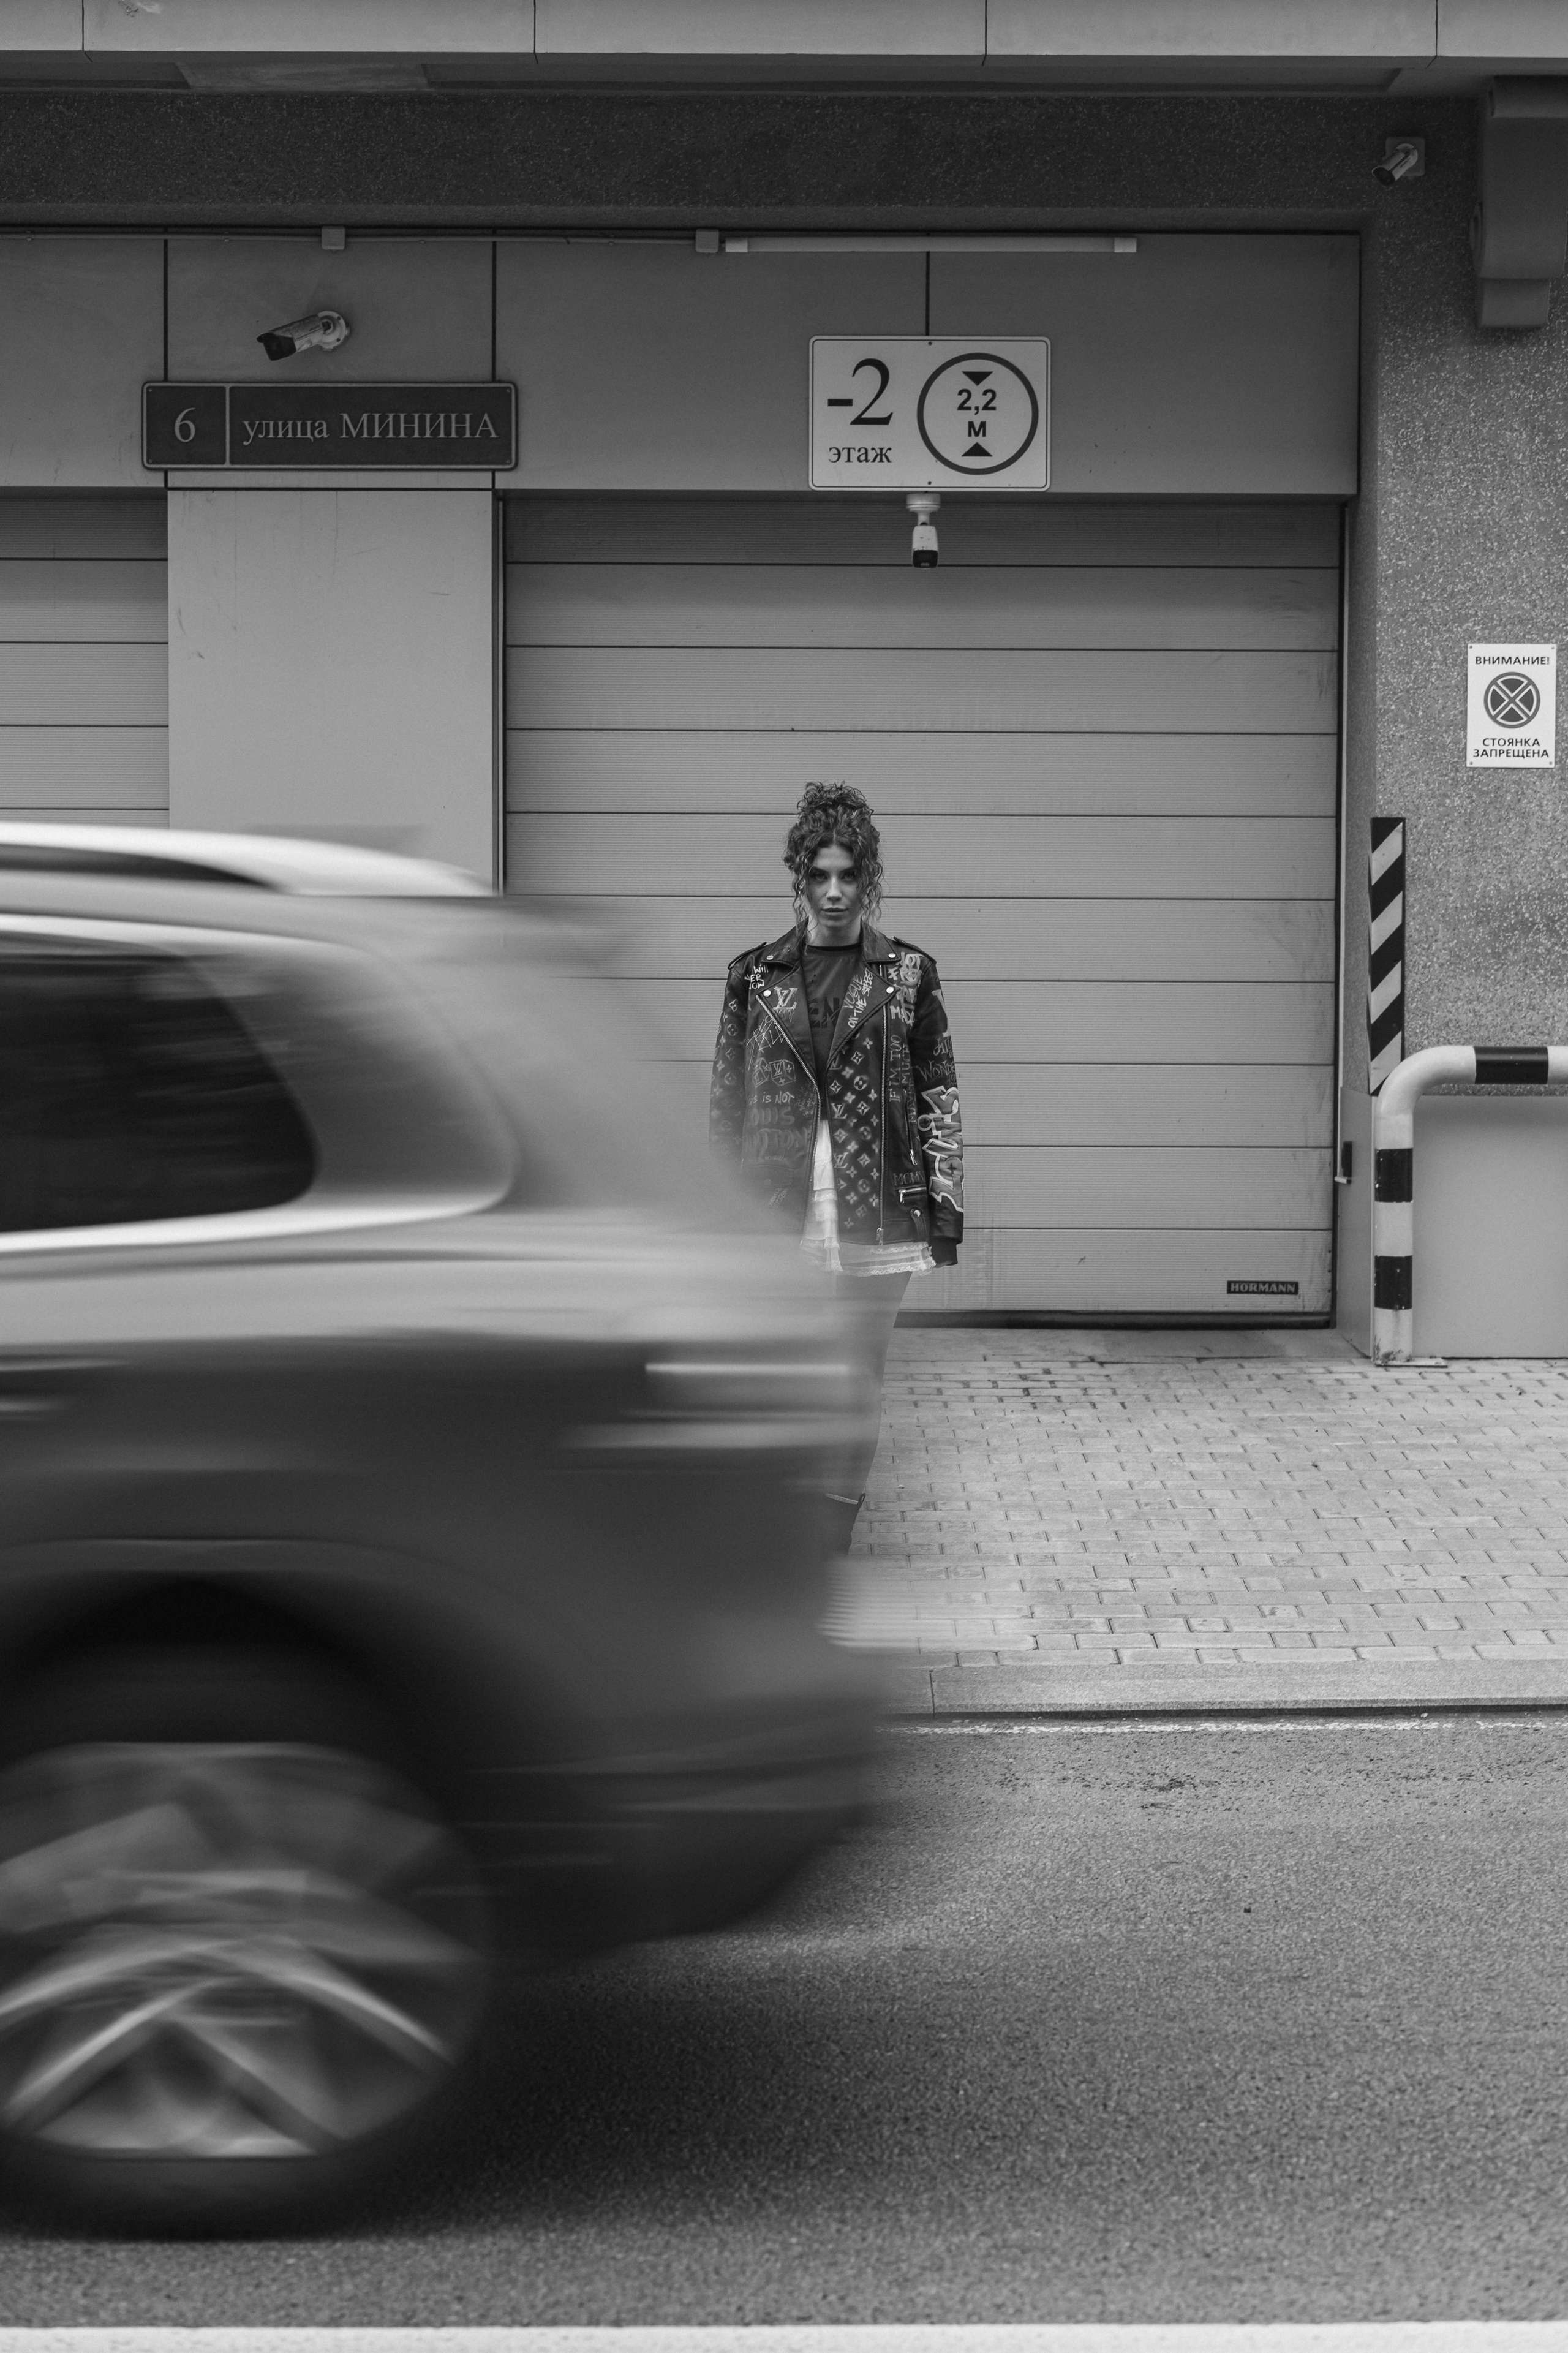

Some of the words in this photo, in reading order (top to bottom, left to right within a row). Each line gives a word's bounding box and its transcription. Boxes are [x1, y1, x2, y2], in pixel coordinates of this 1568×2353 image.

[827, 358, 894, 425] -2
[957, 388, 997, 415] 2,2
[174, 407, 196, 442] 6
[243, 417, 330, 445] улица
[339, 412, 499, 439] МИНИНА
[828, 447, 892, 463] этаж
[1476, 656, 1550, 665] ВНИМАНИЕ!
[1473, 749, 1550, 759] ЗАПРЕЩЕНА
[1483, 738, 1540, 747] СТОЯНКА
[842, 975, 862, 1008] VOGUE
[853, 994, 867, 1017] THE
[890, 1034, 902, 1062] TOO
[775, 1090, 795, 1105] NOT
